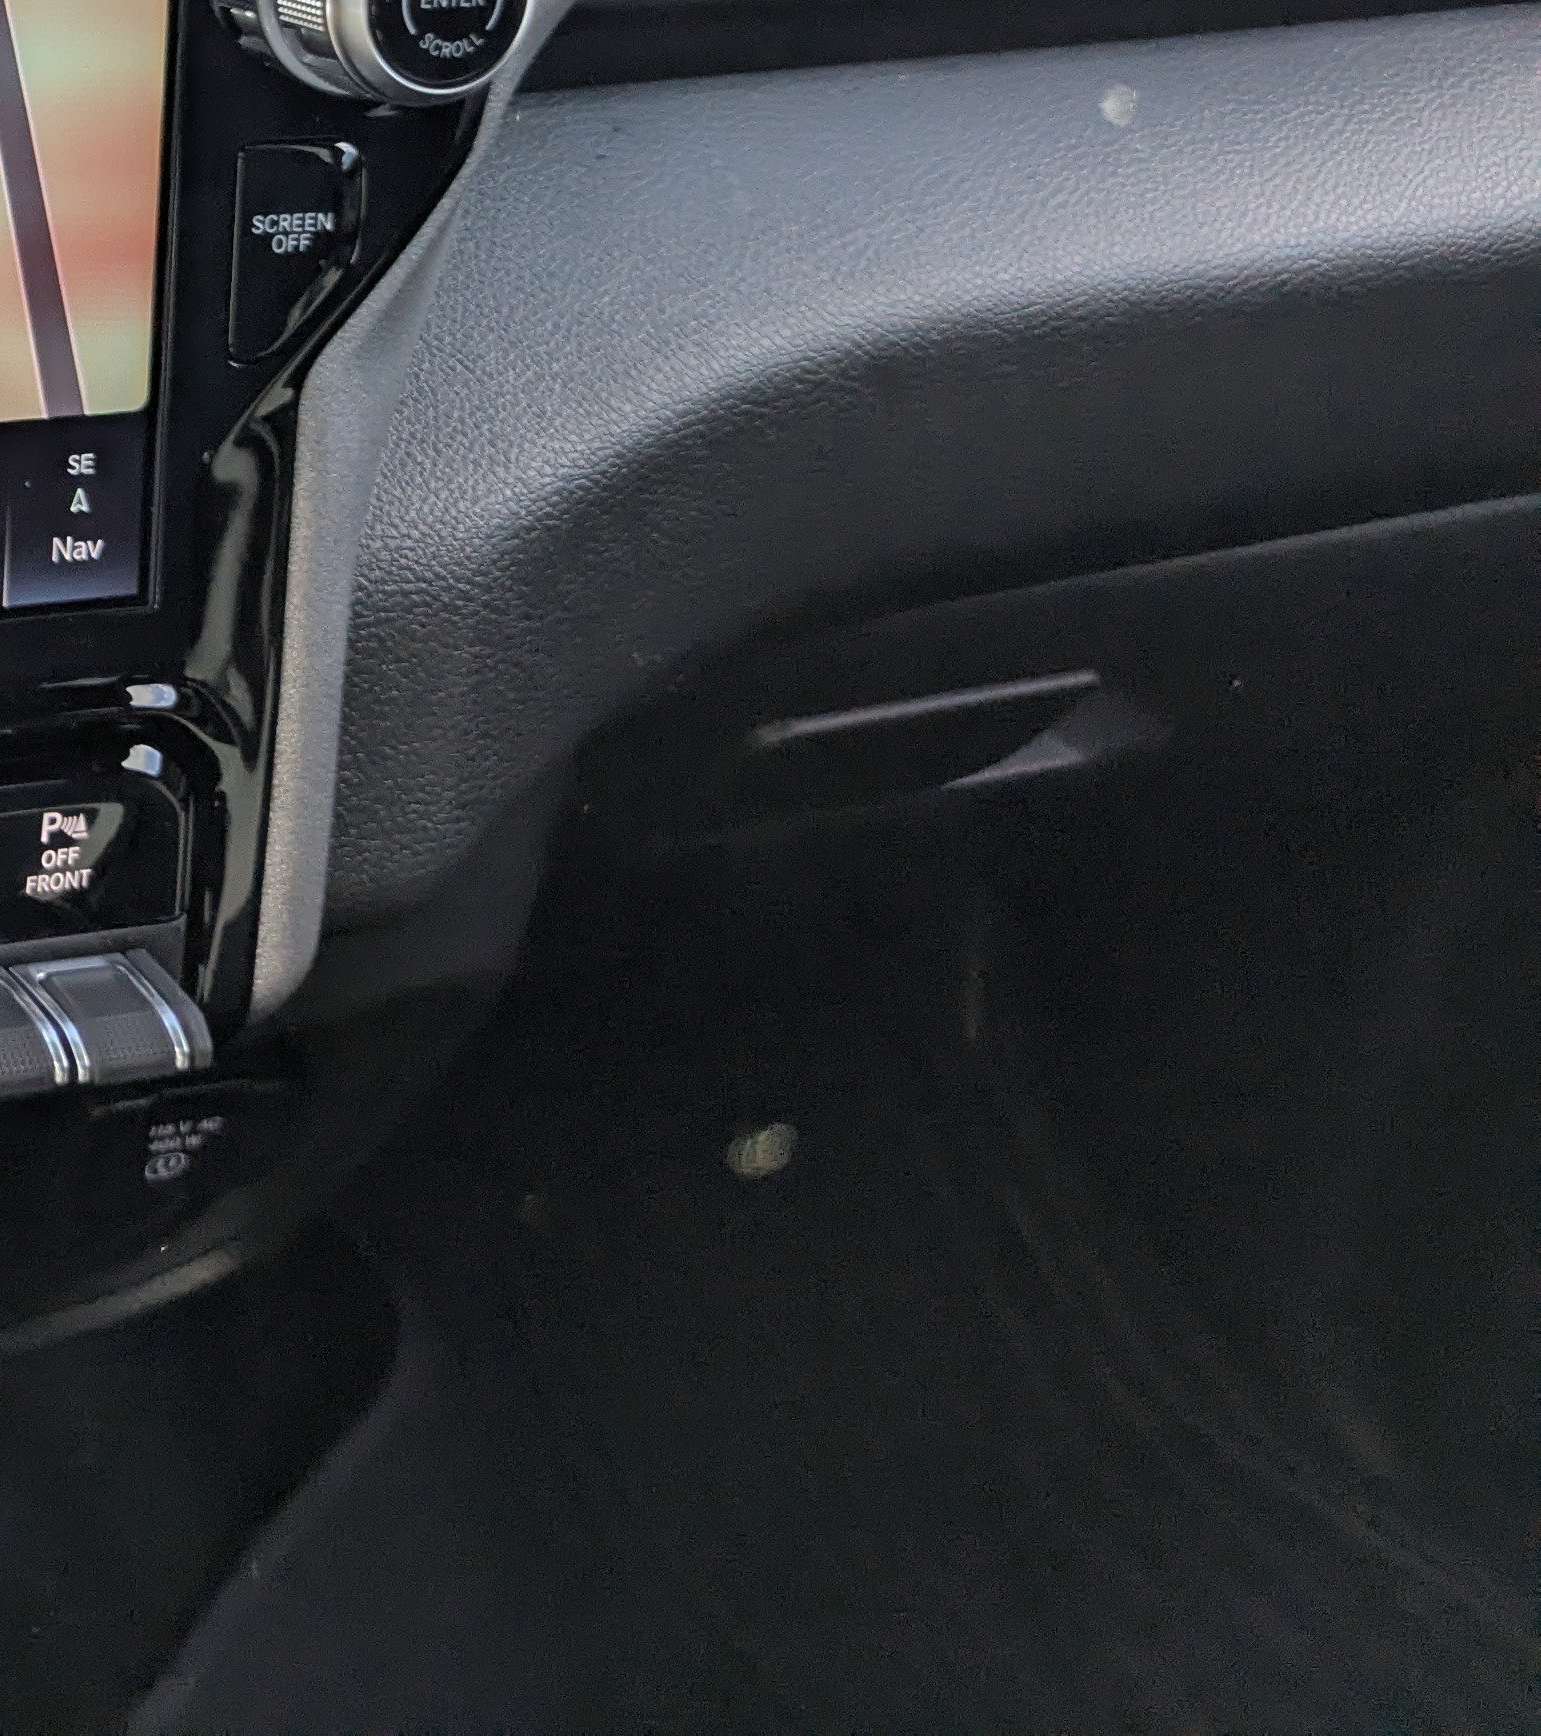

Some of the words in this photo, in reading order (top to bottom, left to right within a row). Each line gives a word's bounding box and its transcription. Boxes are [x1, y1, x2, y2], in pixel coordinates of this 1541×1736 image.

[419, 32, 484, 59] SCROLL
[251, 213, 334, 236] SCREEN
[271, 233, 314, 255] OFF
[67, 453, 96, 475] SE
[51, 535, 105, 564] Nav
[41, 846, 81, 869] OFF
[25, 868, 93, 896] FRONT
